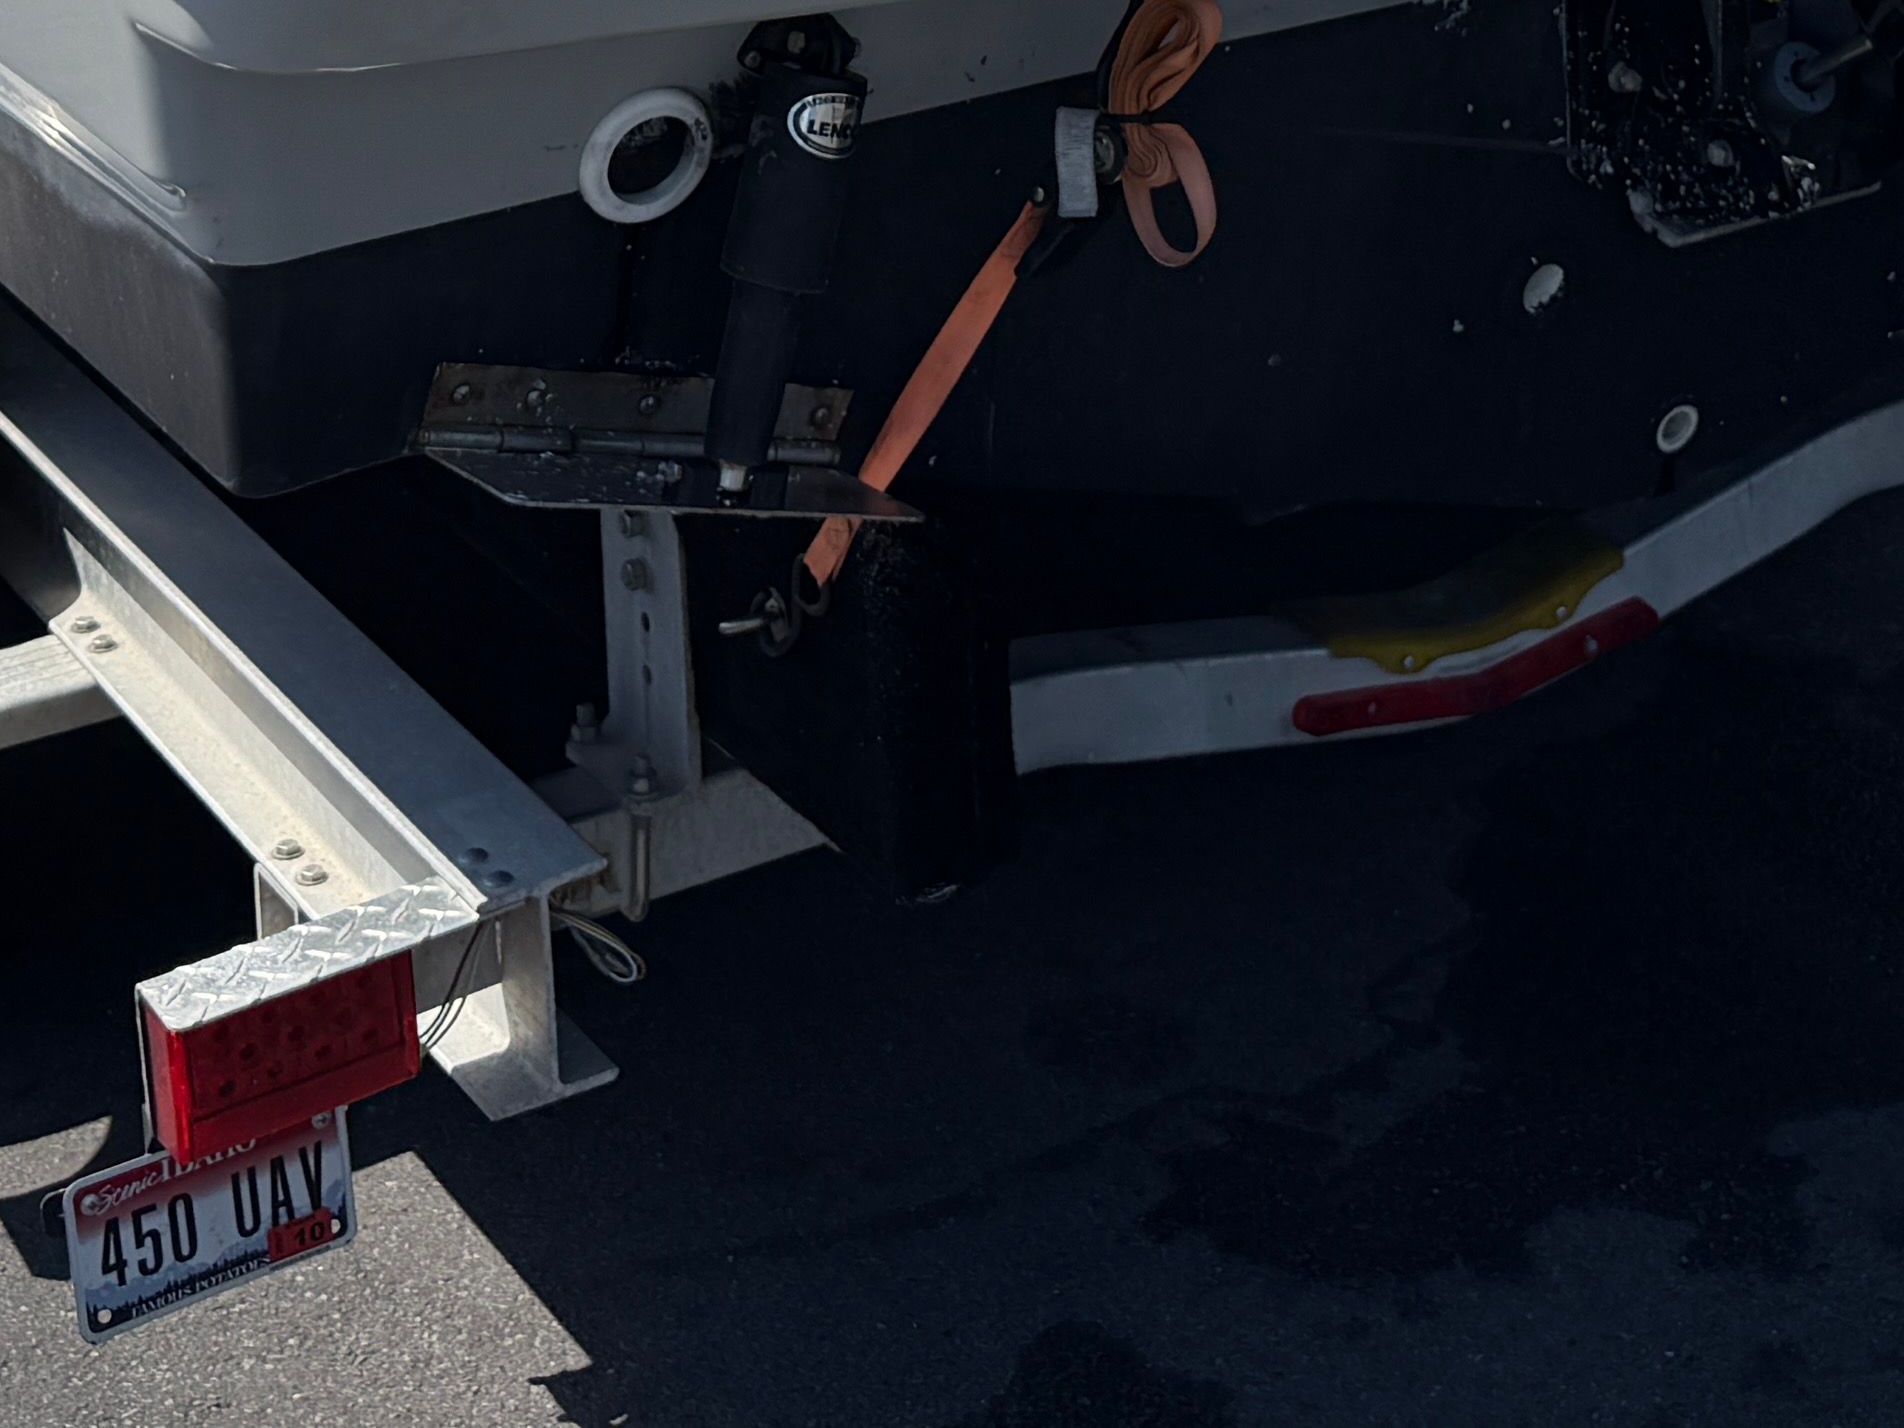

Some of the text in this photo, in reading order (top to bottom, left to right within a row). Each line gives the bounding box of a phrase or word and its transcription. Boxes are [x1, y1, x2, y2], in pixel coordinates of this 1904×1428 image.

[96, 1170, 159, 1215] Scenic
[102, 1192, 198, 1288] 450
[132, 1284, 193, 1319] FAMOUS
